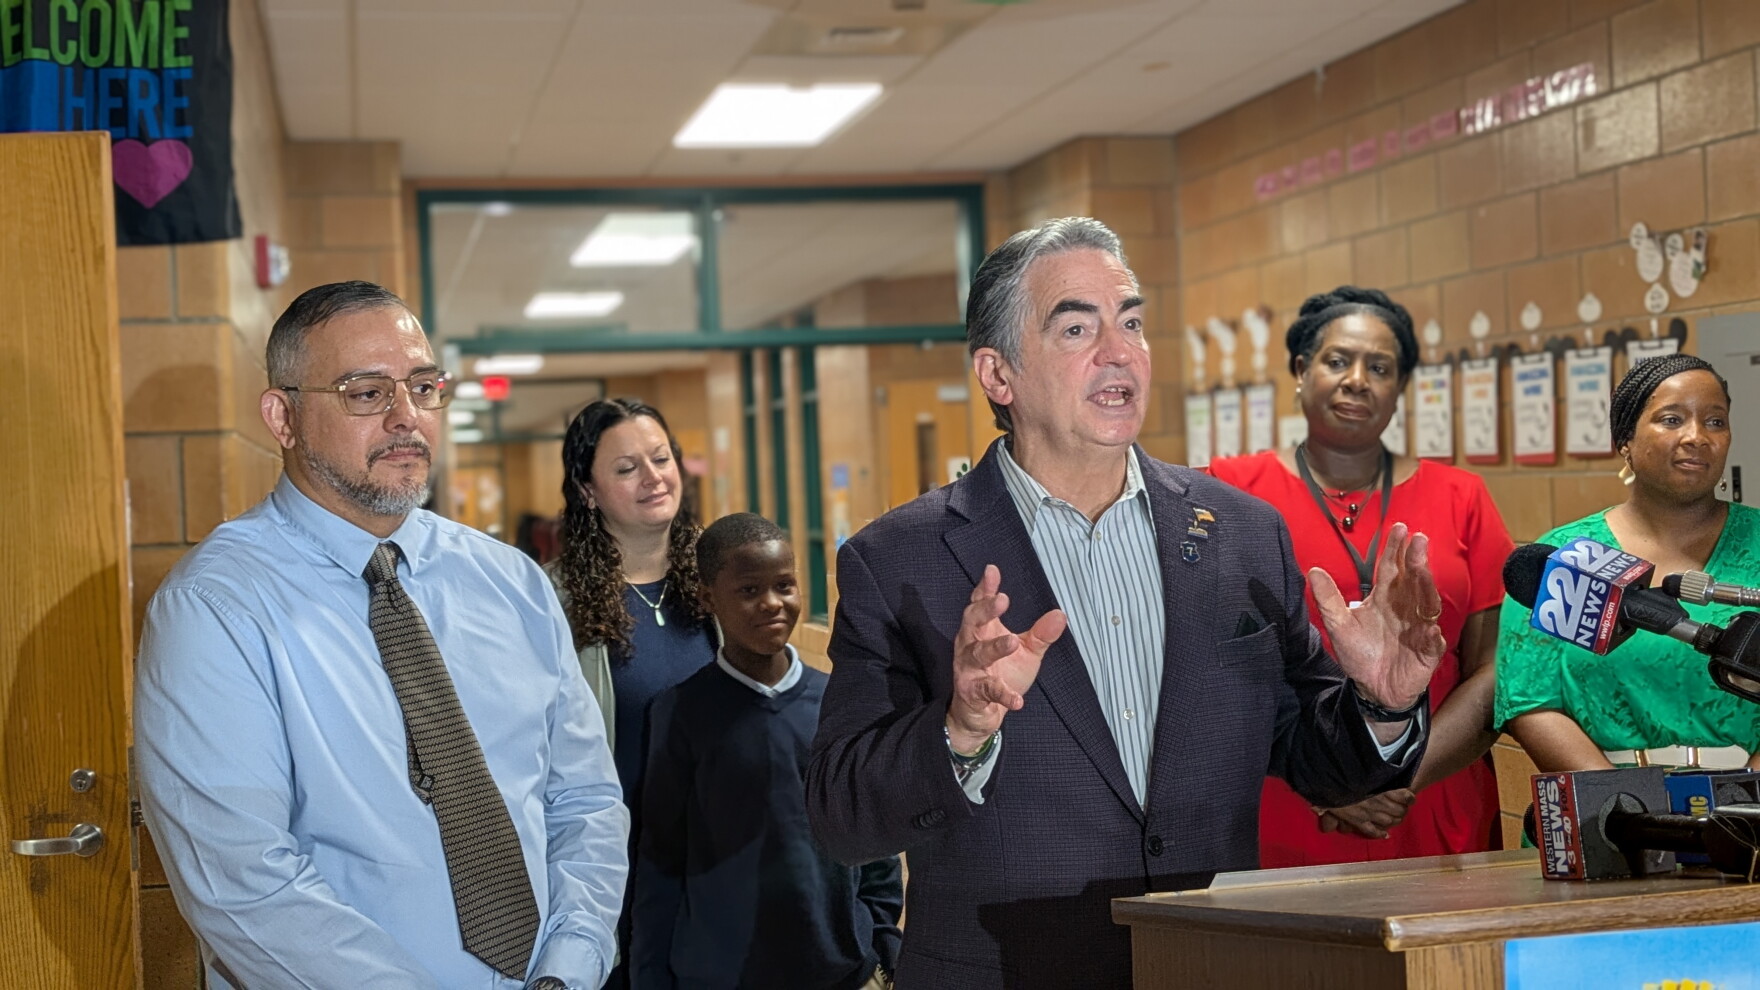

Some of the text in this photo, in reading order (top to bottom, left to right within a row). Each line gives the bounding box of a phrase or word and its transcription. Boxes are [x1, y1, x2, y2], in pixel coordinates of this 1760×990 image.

[0, 0, 193, 68] ELCOME
[64, 67, 193, 138] HERE
[1560, 540, 1621, 573] 22
[1596, 554, 1638, 579] NEWS
[1539, 566, 1591, 641] 22
[1576, 580, 1607, 647] NEWS
[1599, 602, 1615, 640] wwlp.com
[1558, 775, 1566, 785] 6
[1560, 787, 1569, 811] FOX
[1537, 781, 1556, 873] WESTERN MASS
[1547, 780, 1569, 873] NEWS
[1567, 850, 1577, 865] 3
